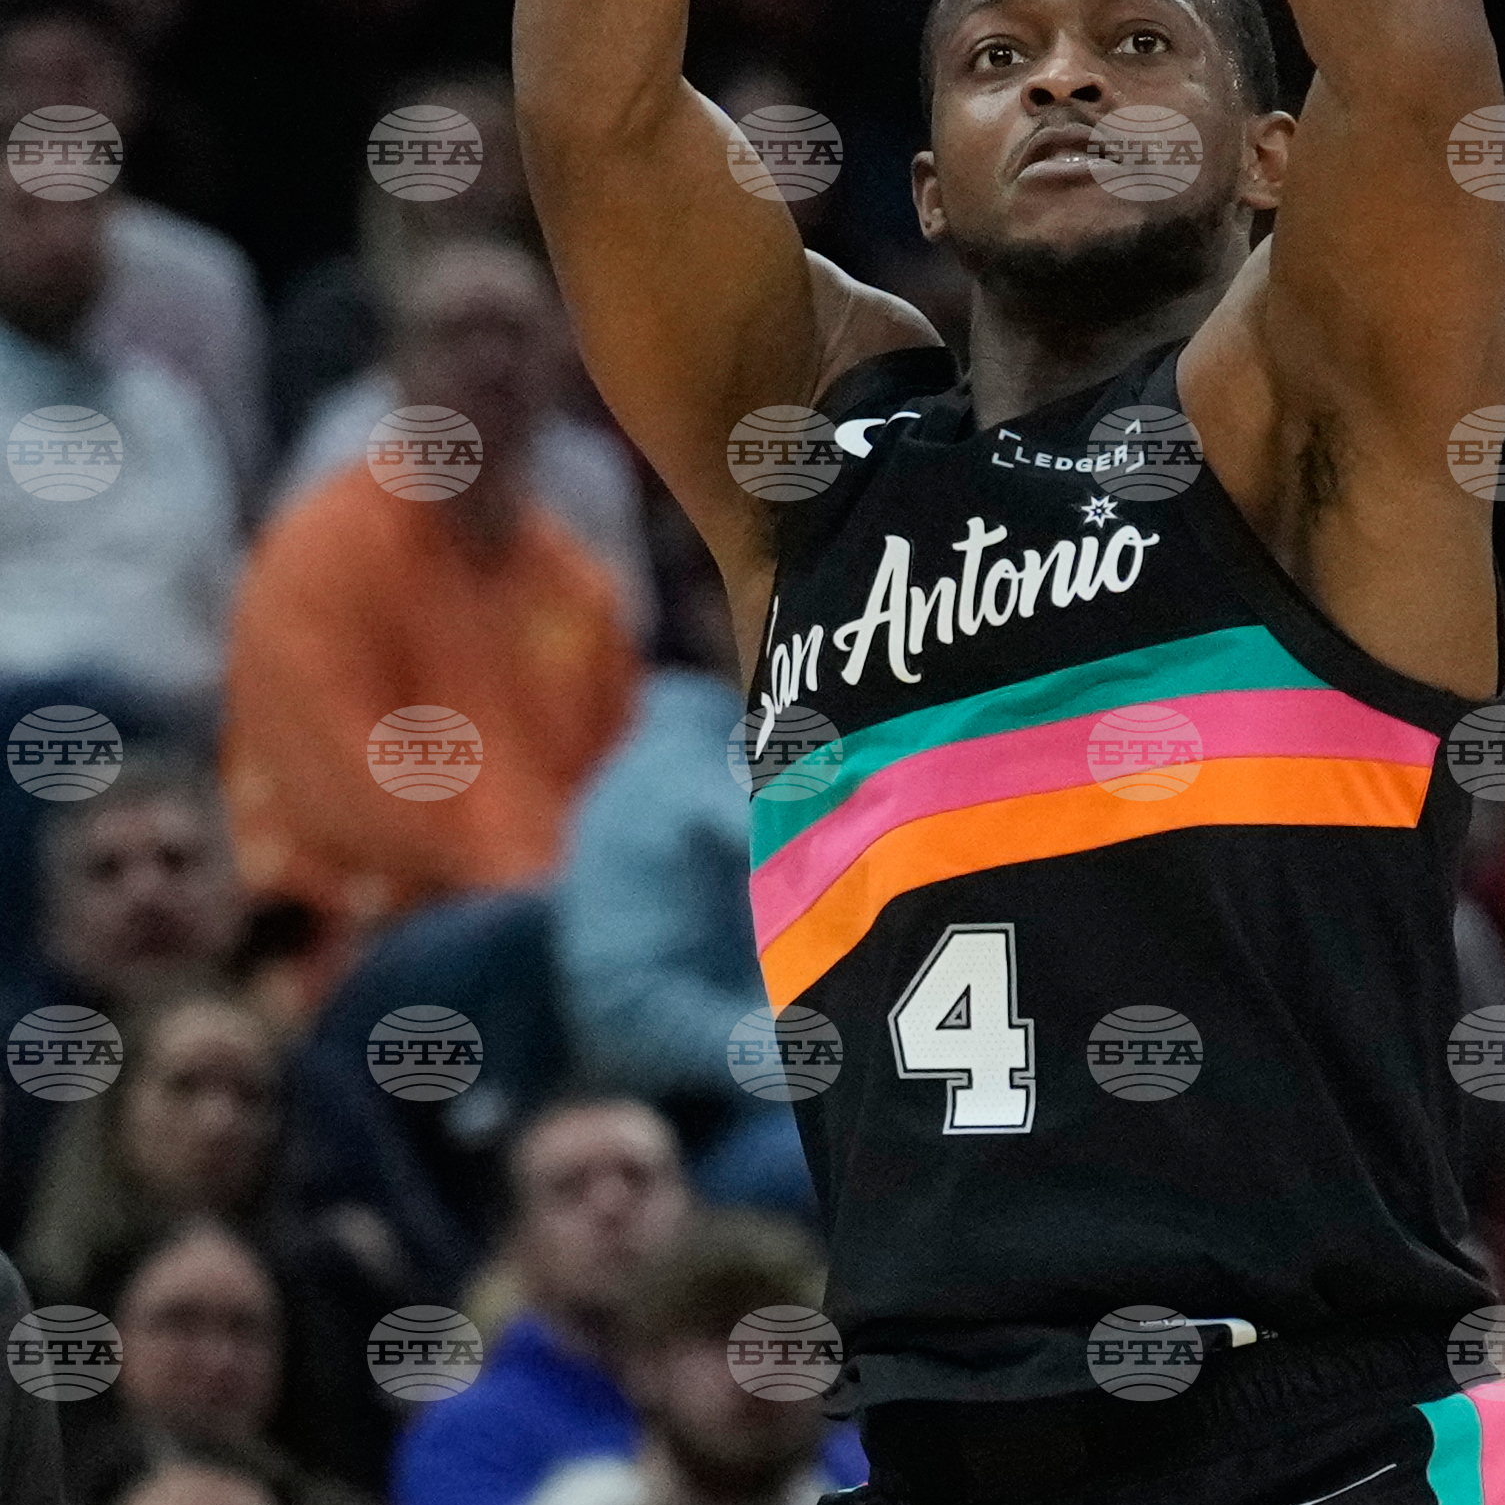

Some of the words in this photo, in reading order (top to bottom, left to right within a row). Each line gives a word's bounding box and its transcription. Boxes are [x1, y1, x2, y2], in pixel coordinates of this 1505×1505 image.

[1014, 444, 1128, 473] LEDGER
[832, 499, 1160, 686] Antonio
[887, 923, 1037, 1135] 4
